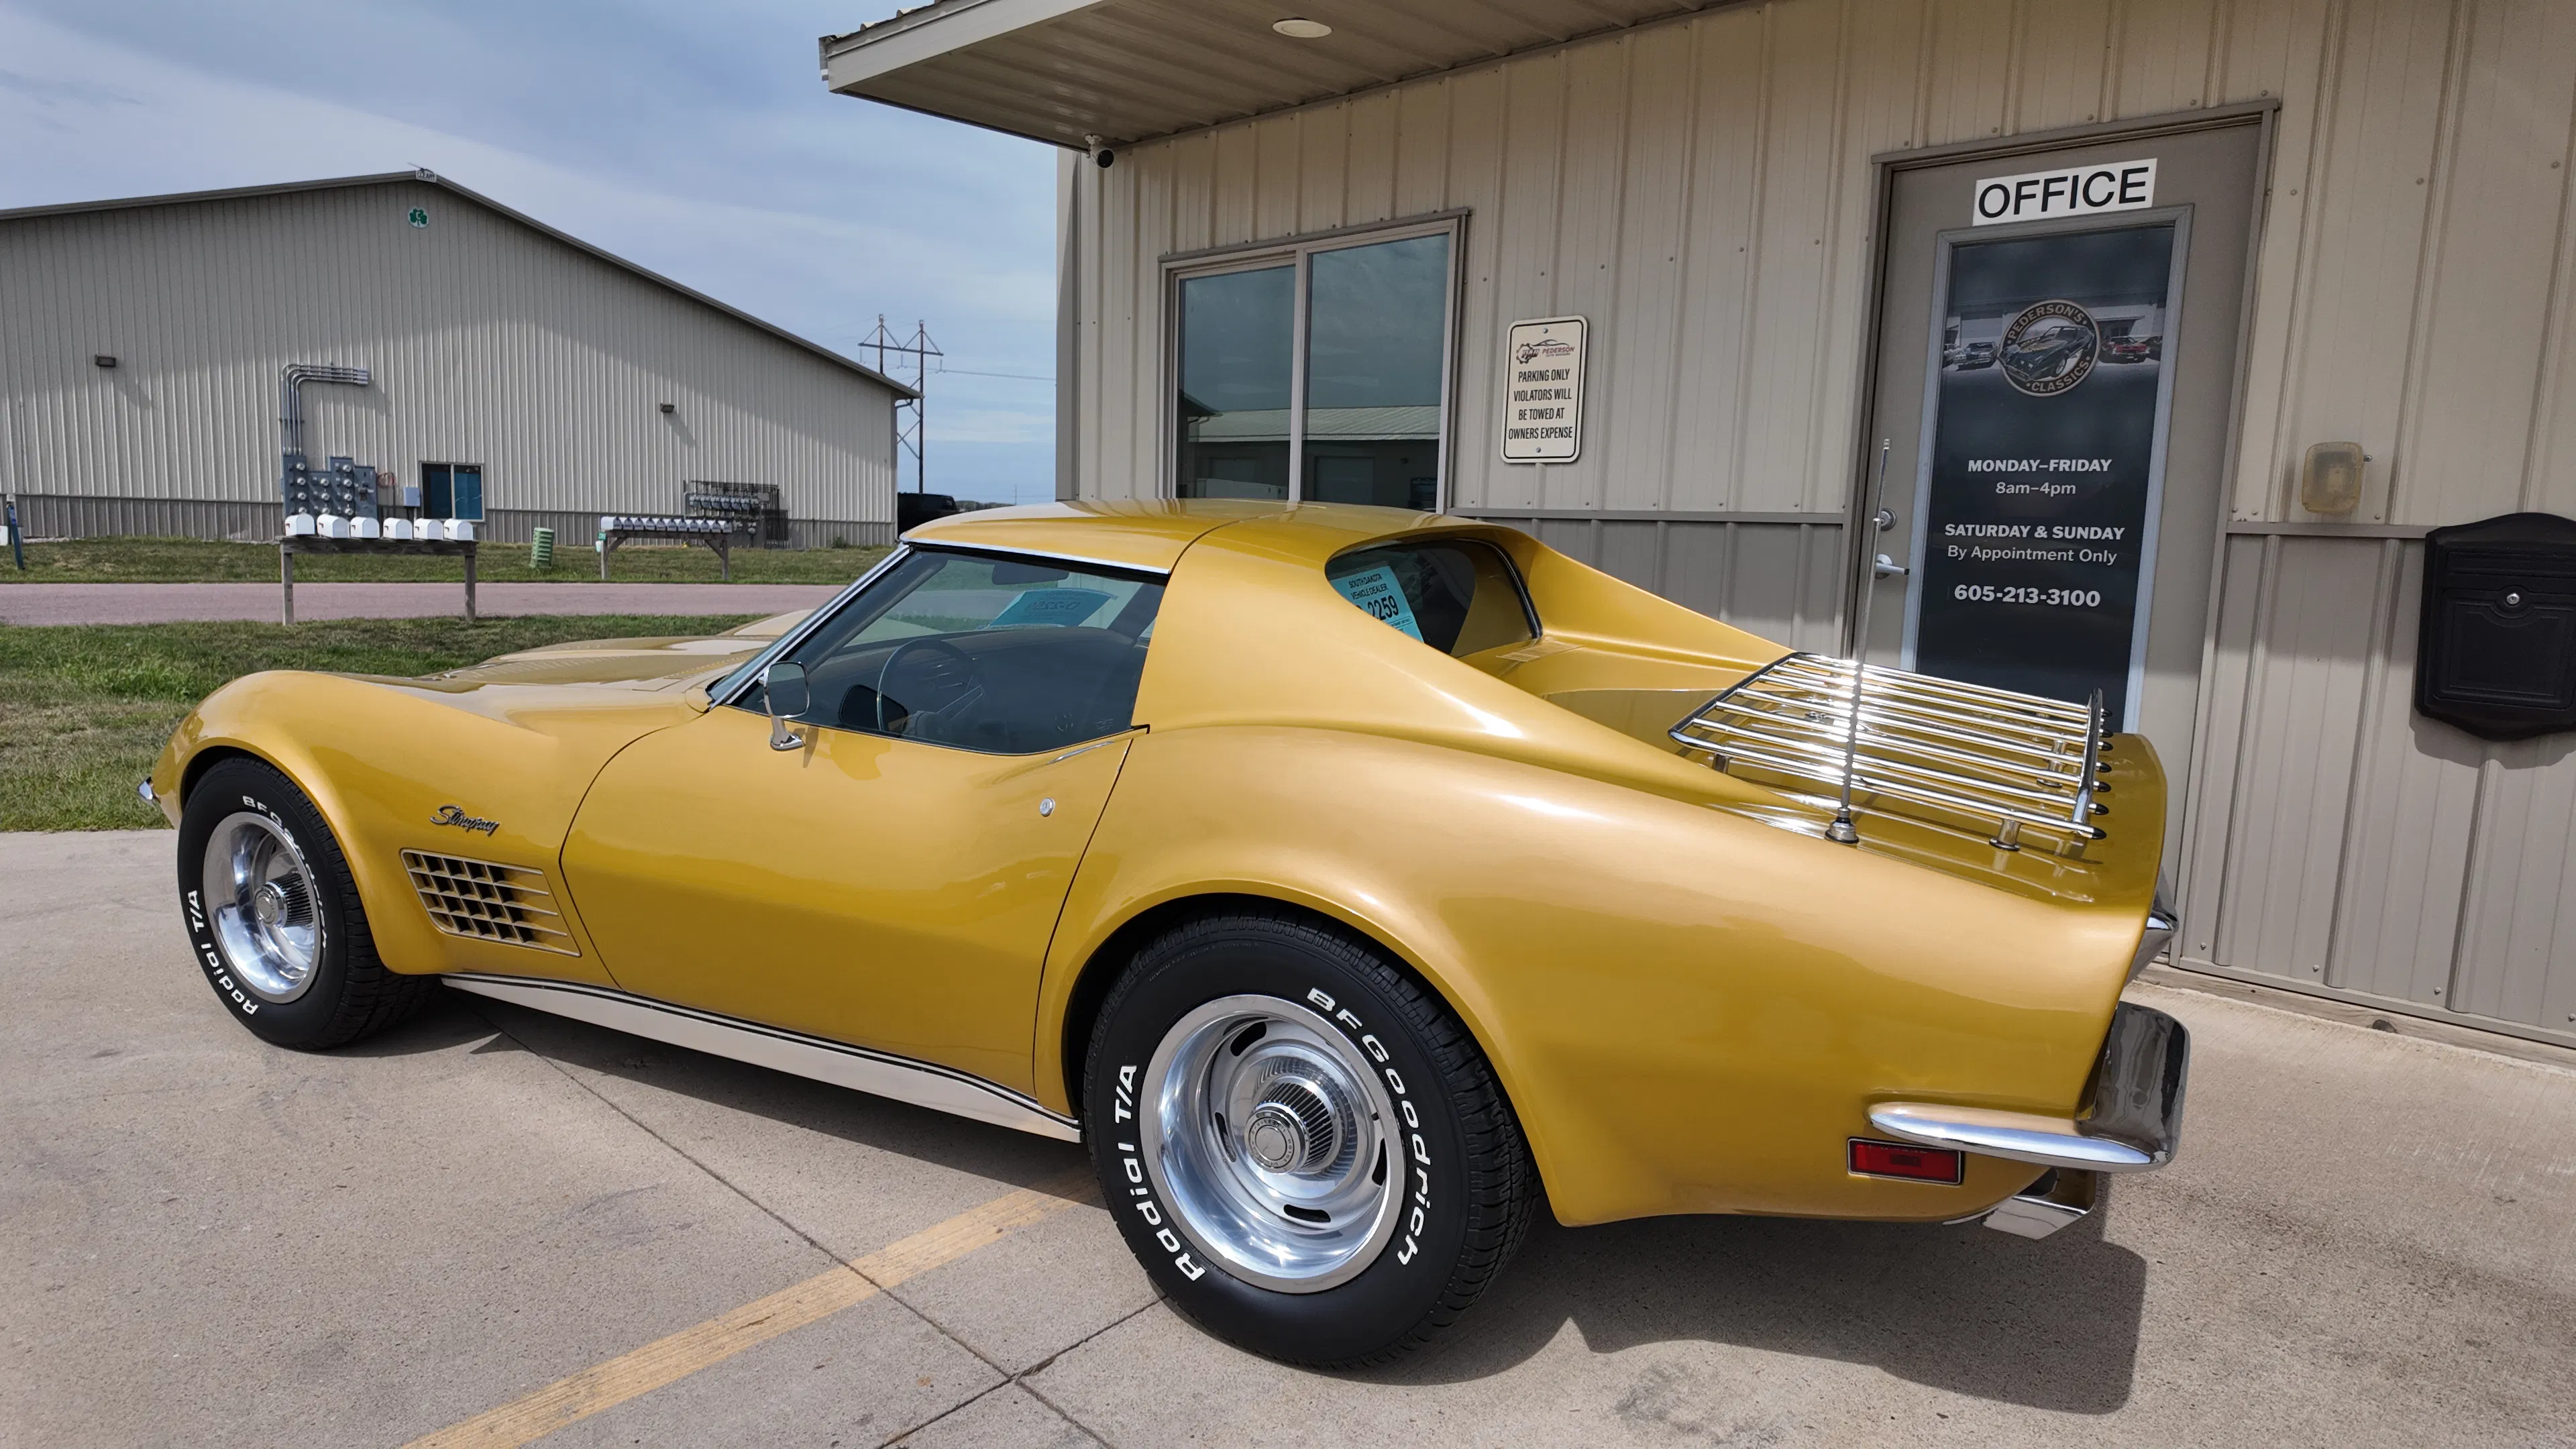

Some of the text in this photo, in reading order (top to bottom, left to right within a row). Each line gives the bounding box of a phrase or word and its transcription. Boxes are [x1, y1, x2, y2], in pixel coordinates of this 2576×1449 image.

[1978, 166, 2149, 219] OFFICE
[2010, 304, 2084, 343] PEDERSON'S
[1542, 346, 1576, 355] PEDERSON
[1517, 368, 1570, 383] PARKING ONLY
[2031, 360, 2090, 392] CLASSICS
[1513, 388, 1572, 402] VIOLATORS WILL
[1518, 407, 1565, 421] BE TOWED AT
[1508, 427, 1573, 440] OWNERS EXPENSE
[1945, 523, 2125, 540] SATURDAY & SUNDAY
[1947, 545, 2118, 566] By Appointment Only
[1348, 573, 1383, 589] SOUTH DAKOTA
[1350, 583, 1389, 600] VEHICLE DEALER
[1953, 584, 2101, 607] 605-213-3100
[429, 804, 500, 837] Stingray
[187, 890, 259, 1015] Radial T/A
[1306, 987, 1433, 1266] BFGoodrich
[1114, 1065, 1207, 1282] Radial T/A
